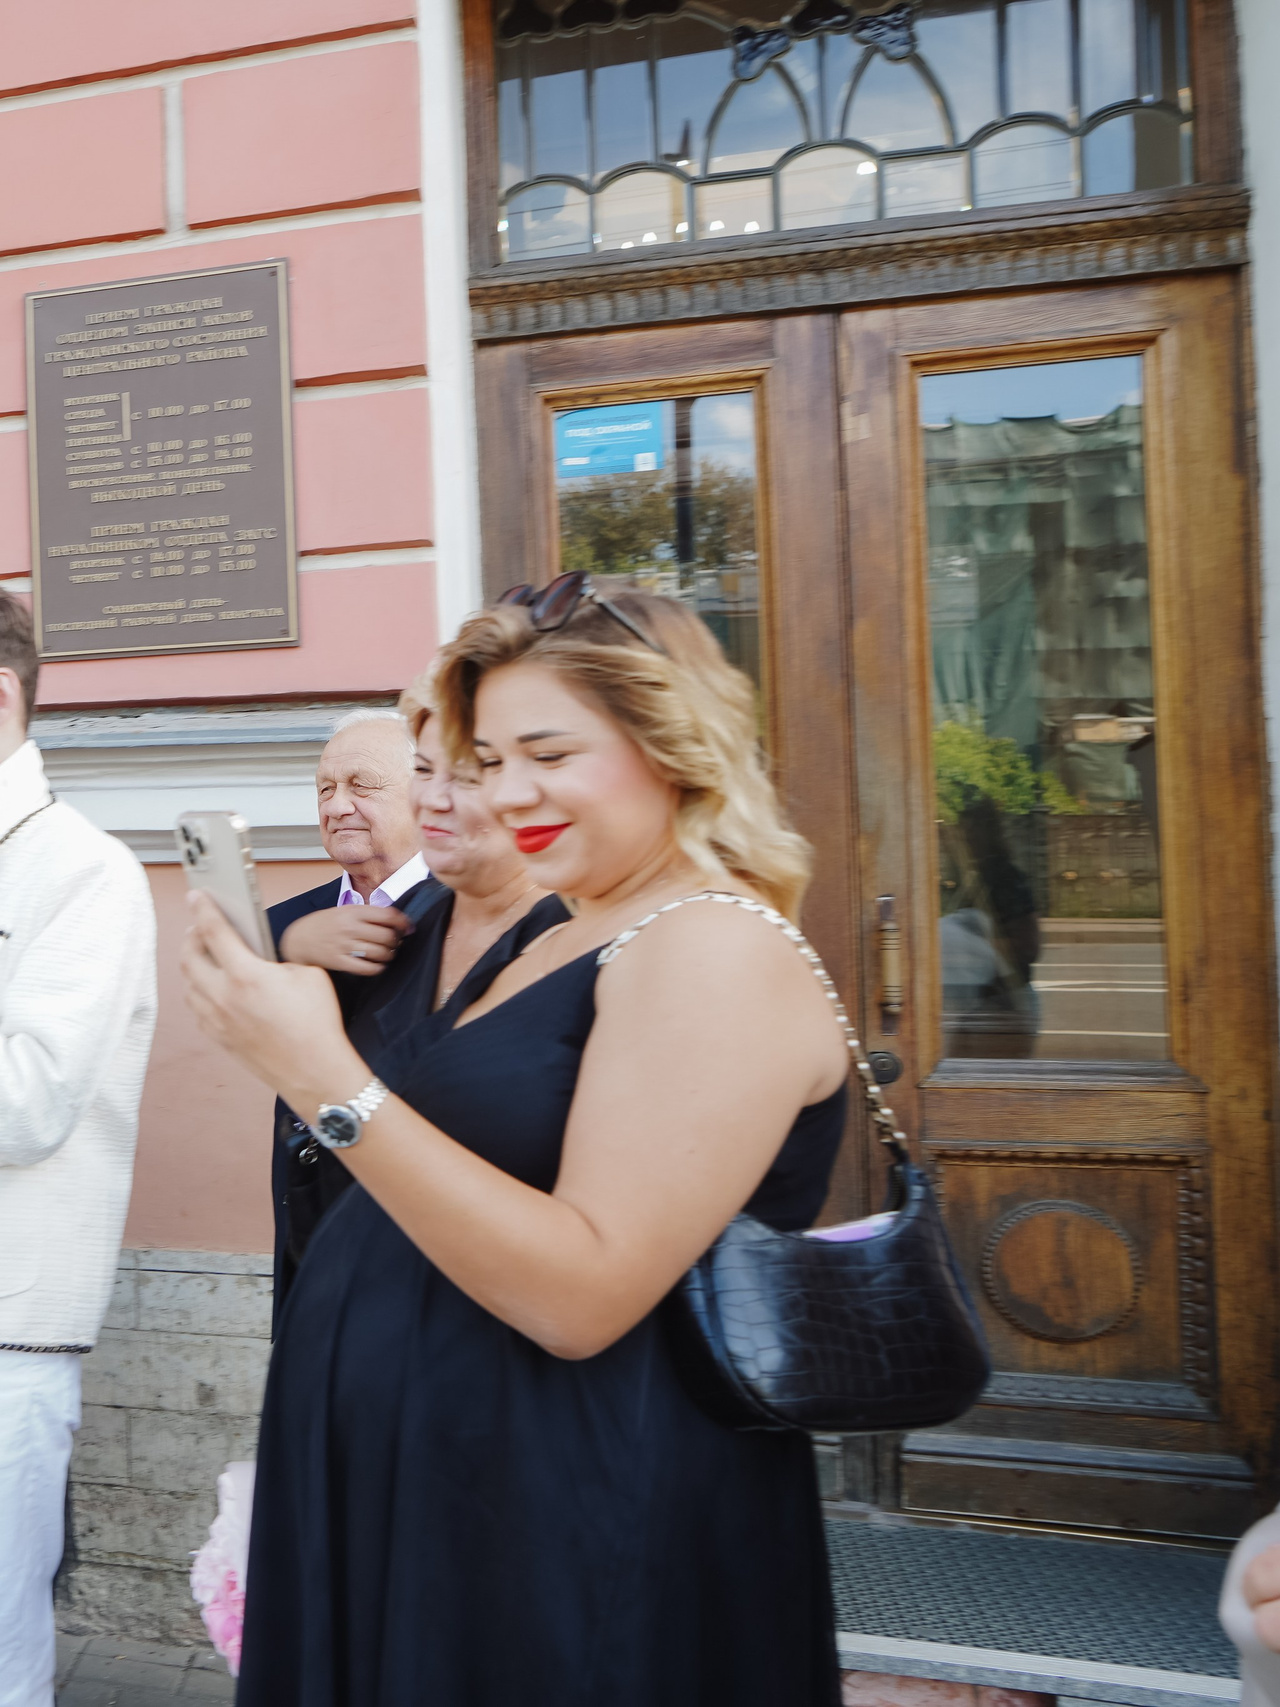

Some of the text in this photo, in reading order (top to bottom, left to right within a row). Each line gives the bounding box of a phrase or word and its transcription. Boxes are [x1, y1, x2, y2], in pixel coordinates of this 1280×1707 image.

[143, 296, 223, 317] ГРАЖДАН
[133, 317, 197, 335] ЗАПИСИ
[147, 406, 184, 418] 10.00
[188, 404, 210, 416] до
[213, 397, 252, 412] 17.00
[146, 440, 183, 453] 10.00
[187, 439, 209, 450] до
[213, 432, 253, 447] 16.00
[187, 453, 209, 464] до
[180, 480, 226, 497] ДЕНЬ
[150, 515, 230, 533] ГРАЖДАН
[233, 527, 278, 541] ЗАГС
[190, 549, 212, 561] до
[218, 544, 256, 558] 17.00
[189, 564, 211, 576] до
